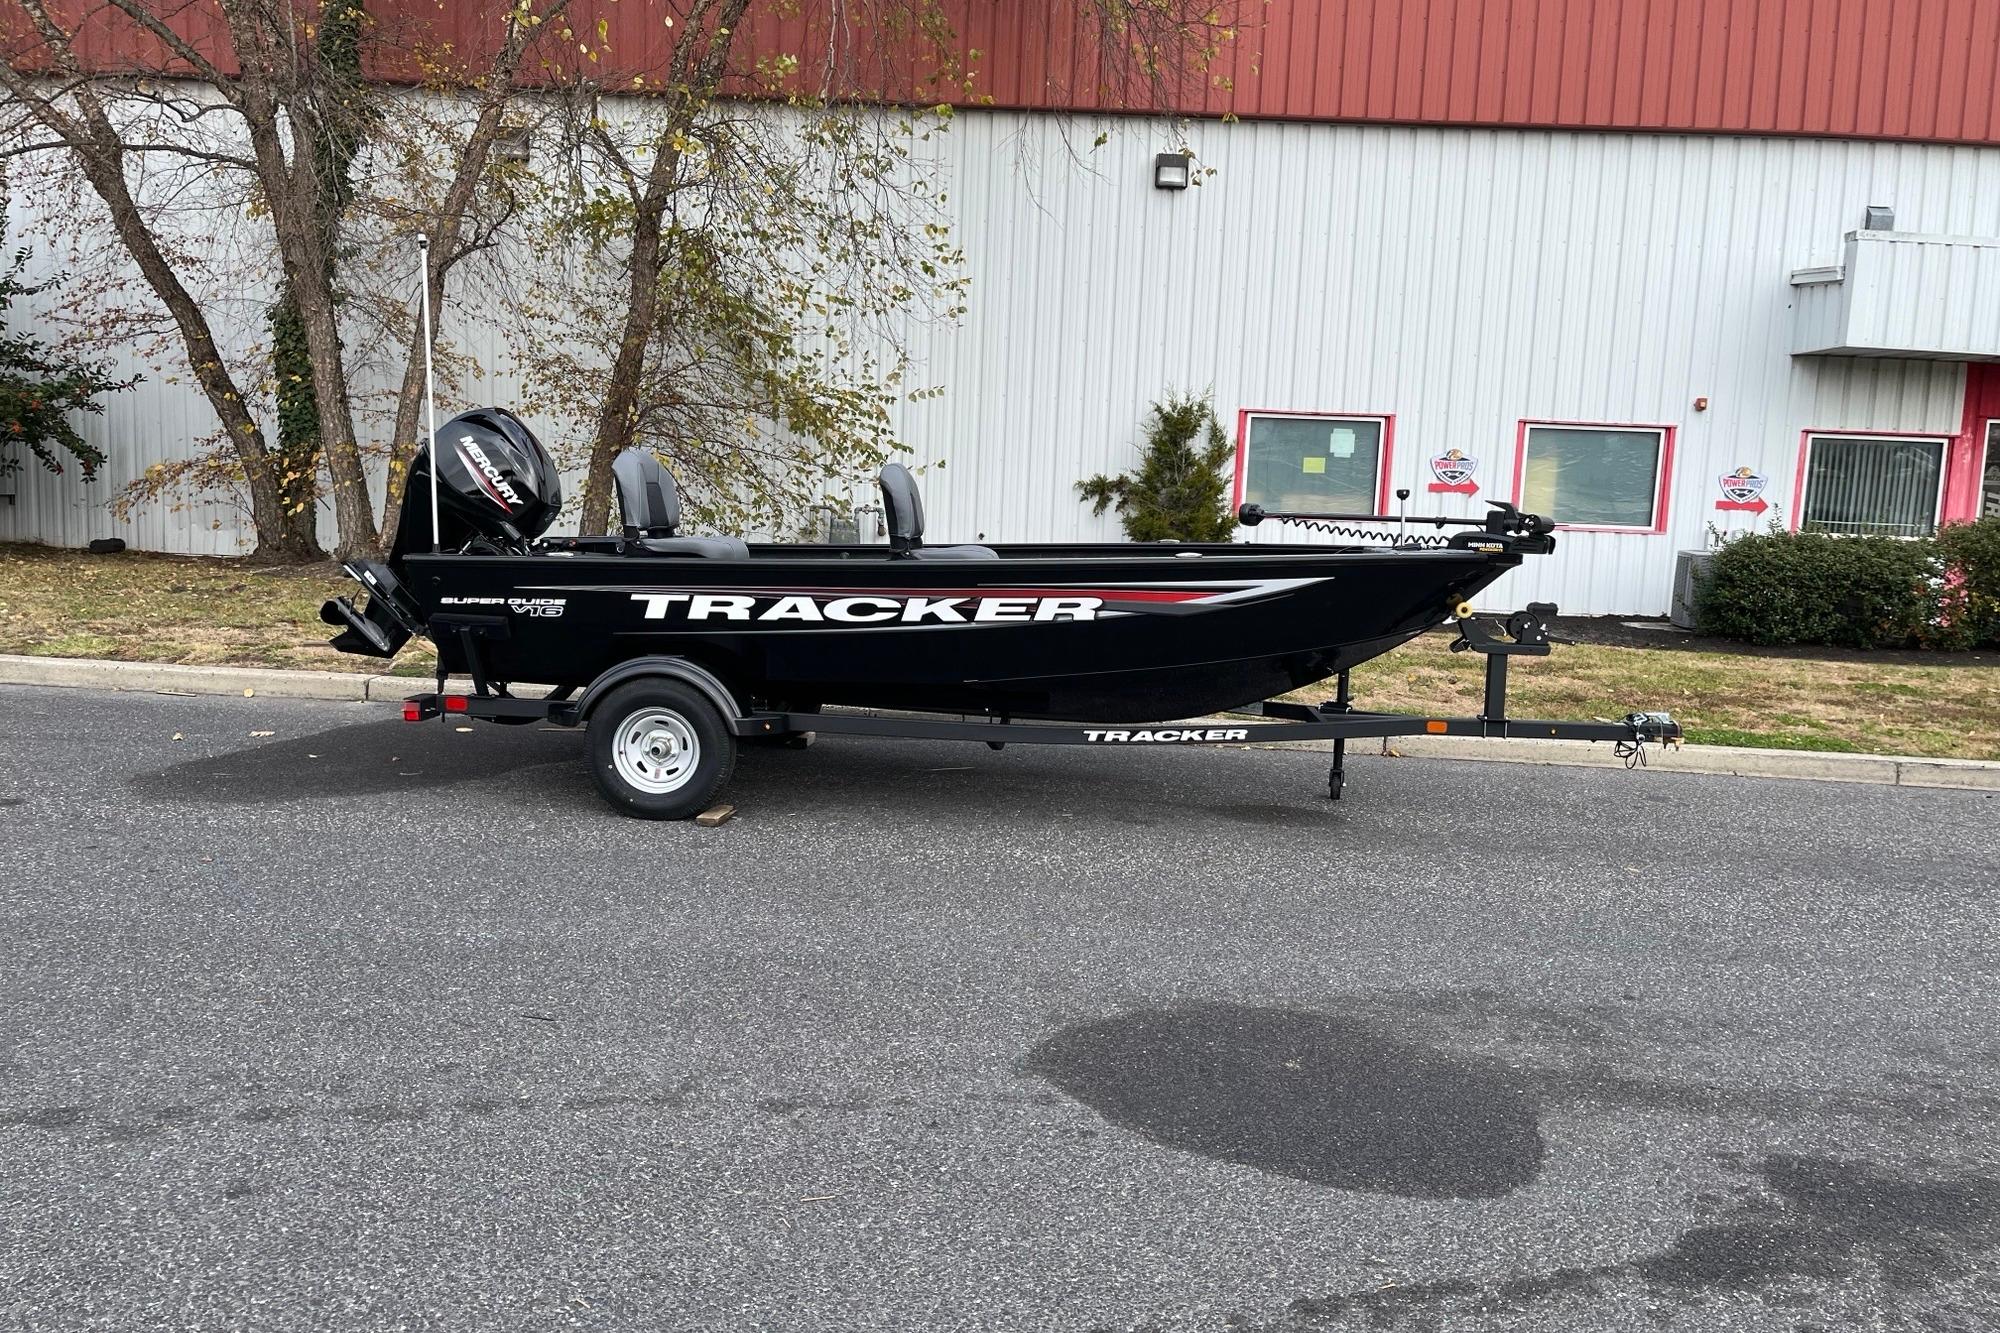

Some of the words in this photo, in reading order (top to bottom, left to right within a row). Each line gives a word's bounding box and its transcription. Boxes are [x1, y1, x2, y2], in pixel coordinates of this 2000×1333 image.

[459, 435, 524, 505] MERCURY
[440, 597, 505, 605] SUPER
[507, 598, 567, 606] GUIDE
[630, 593, 1104, 622] TRACKER
[511, 605, 564, 617] V16
[1083, 729, 1249, 742] TRACKER
